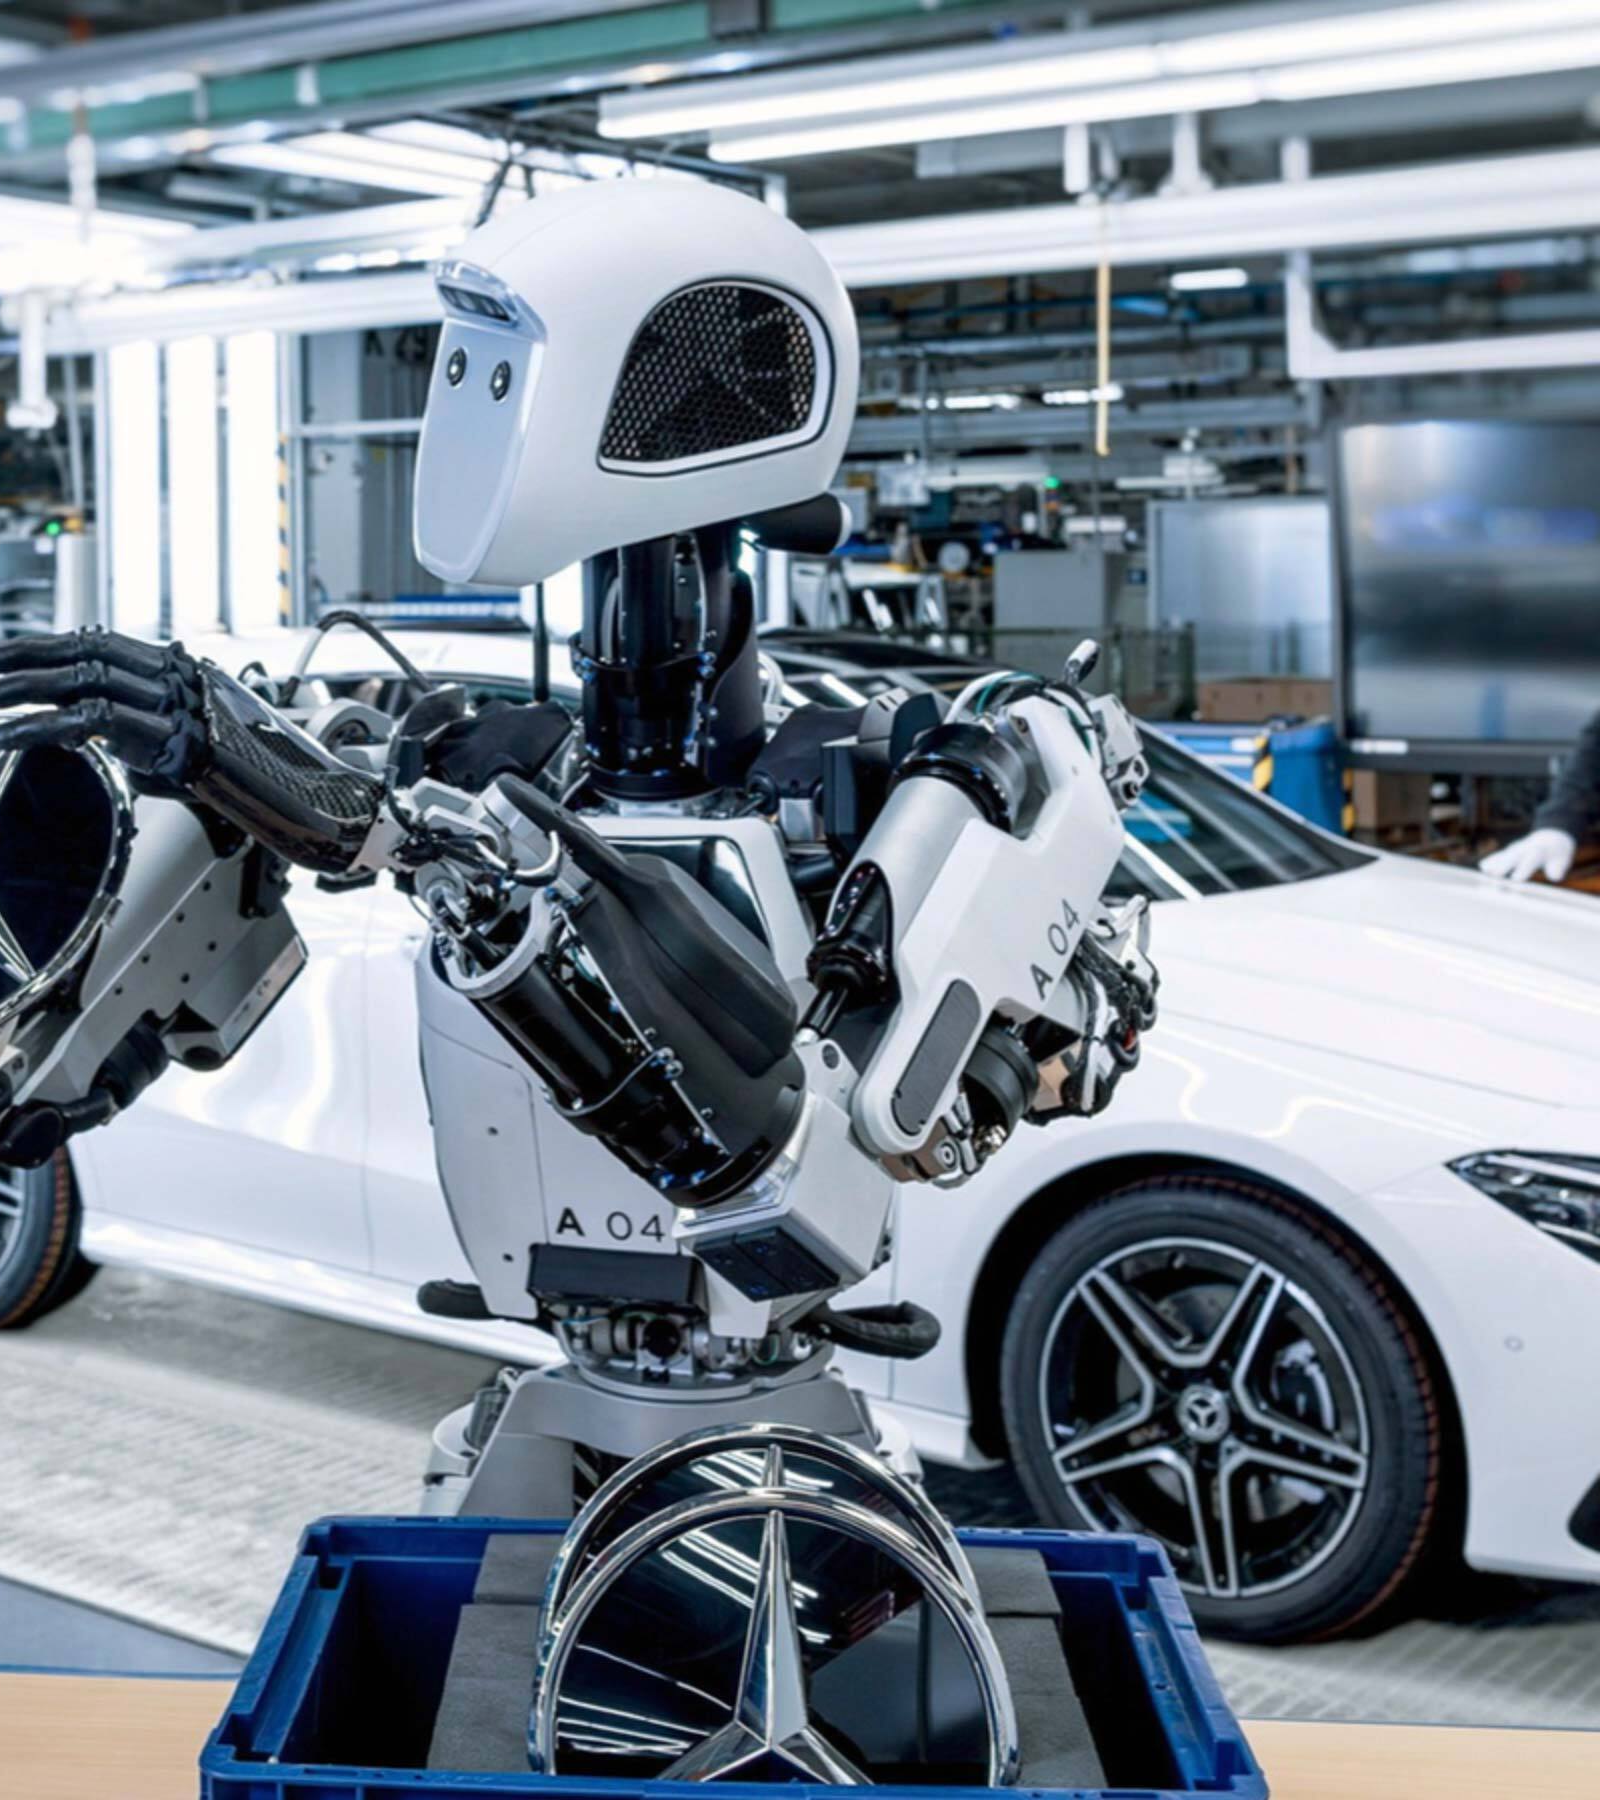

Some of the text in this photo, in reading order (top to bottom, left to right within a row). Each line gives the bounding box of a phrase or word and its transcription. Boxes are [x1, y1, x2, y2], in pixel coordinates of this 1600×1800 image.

[1030, 898, 1081, 1001] A 04
[556, 1206, 665, 1243] A 04
